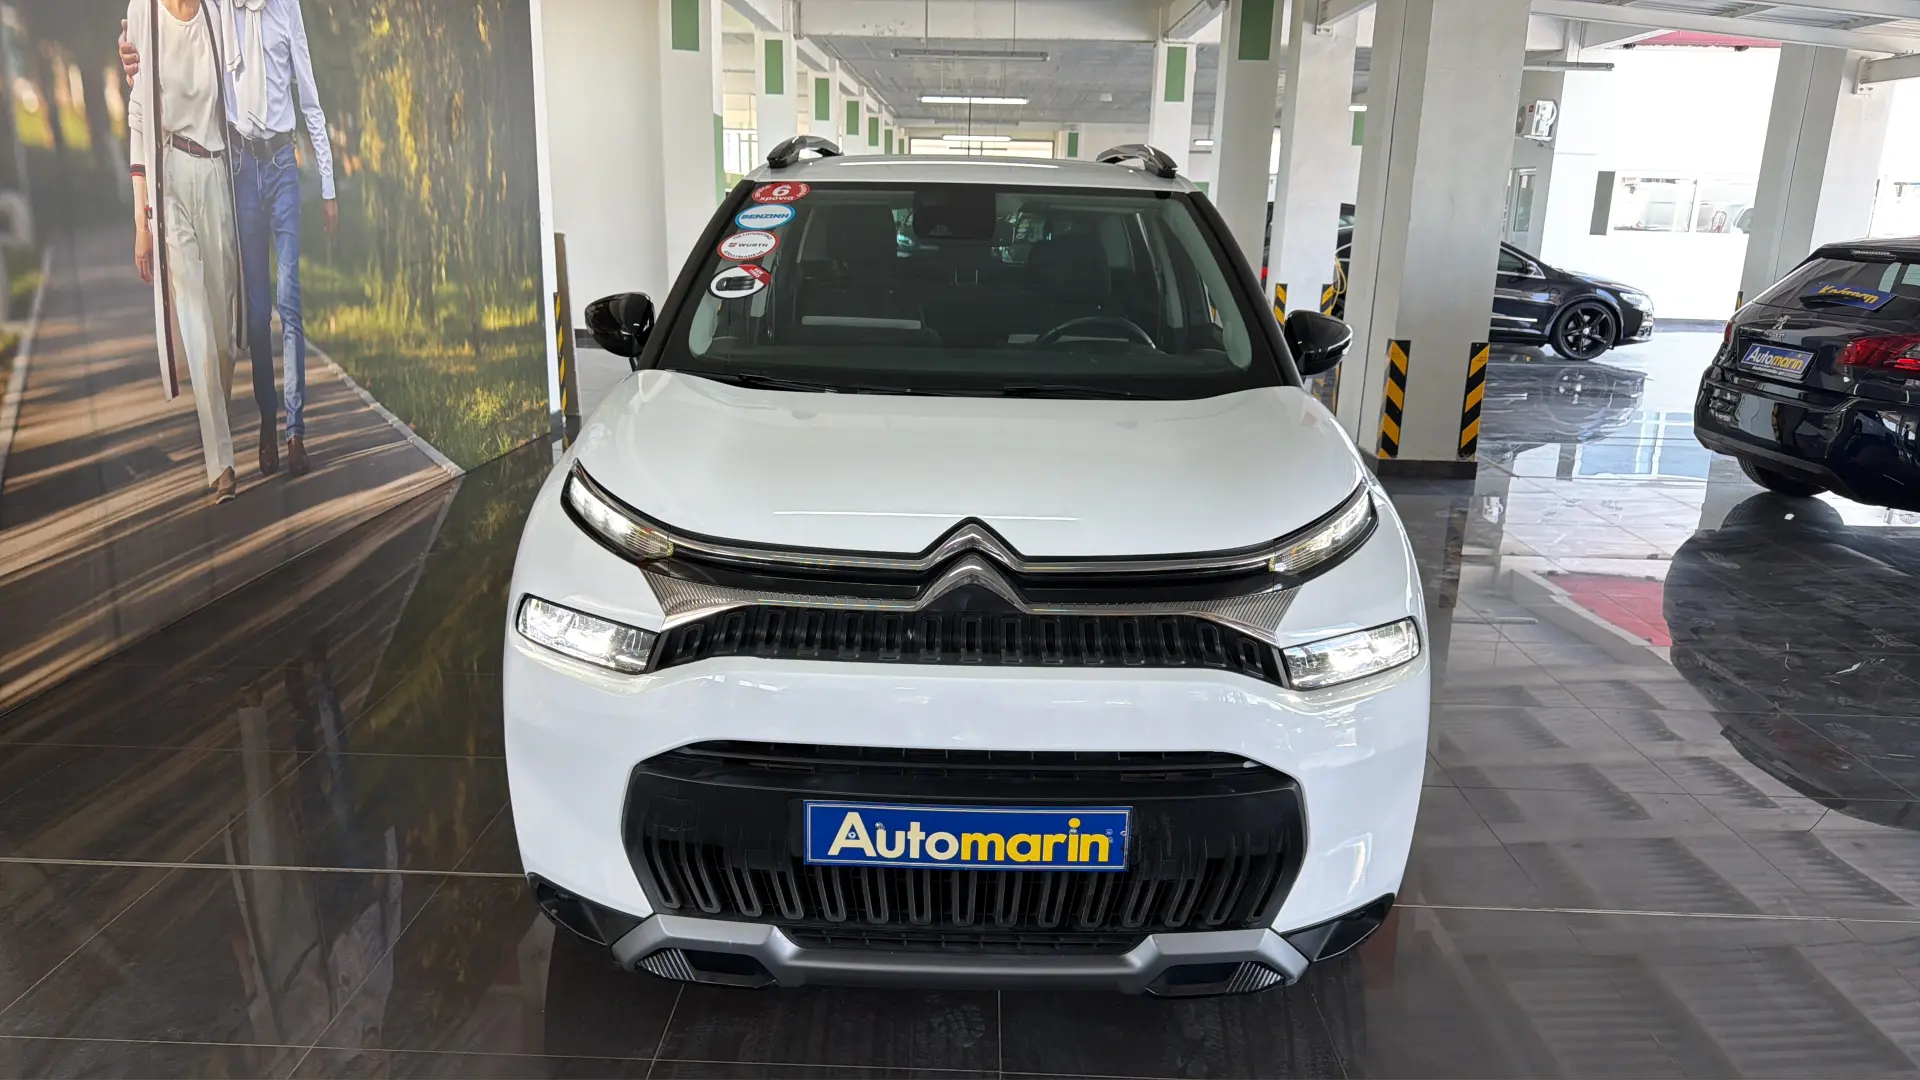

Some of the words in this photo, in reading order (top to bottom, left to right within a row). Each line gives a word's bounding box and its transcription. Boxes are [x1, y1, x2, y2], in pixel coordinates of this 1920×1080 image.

[772, 185, 791, 197] 6
[1747, 346, 1804, 370] Automarin
[827, 812, 1110, 862] Automarin
